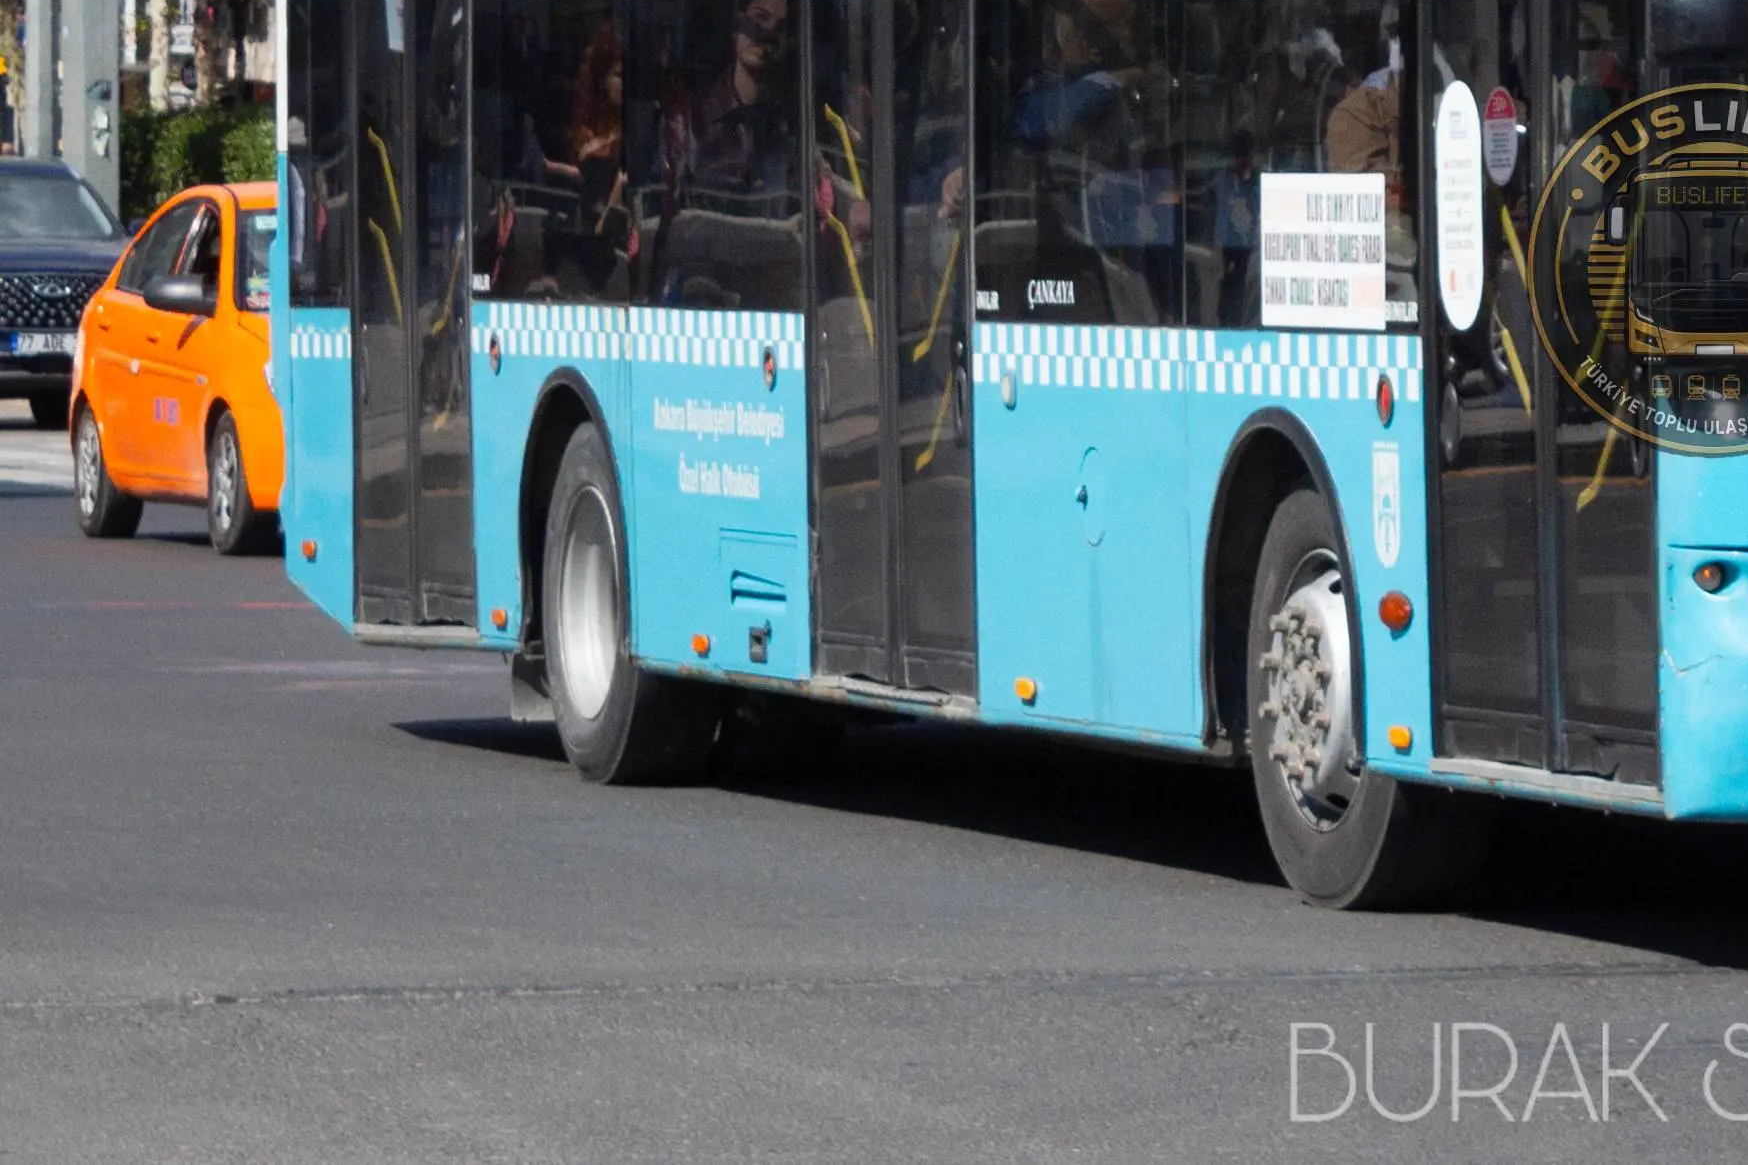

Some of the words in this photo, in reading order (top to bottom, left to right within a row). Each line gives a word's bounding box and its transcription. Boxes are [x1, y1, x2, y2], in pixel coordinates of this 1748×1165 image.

[1028, 279, 1075, 310] ÇANKAYA
[654, 397, 685, 431] Ankara
[686, 399, 736, 443] Büyükşehir
[737, 401, 785, 447] Belediyesi
